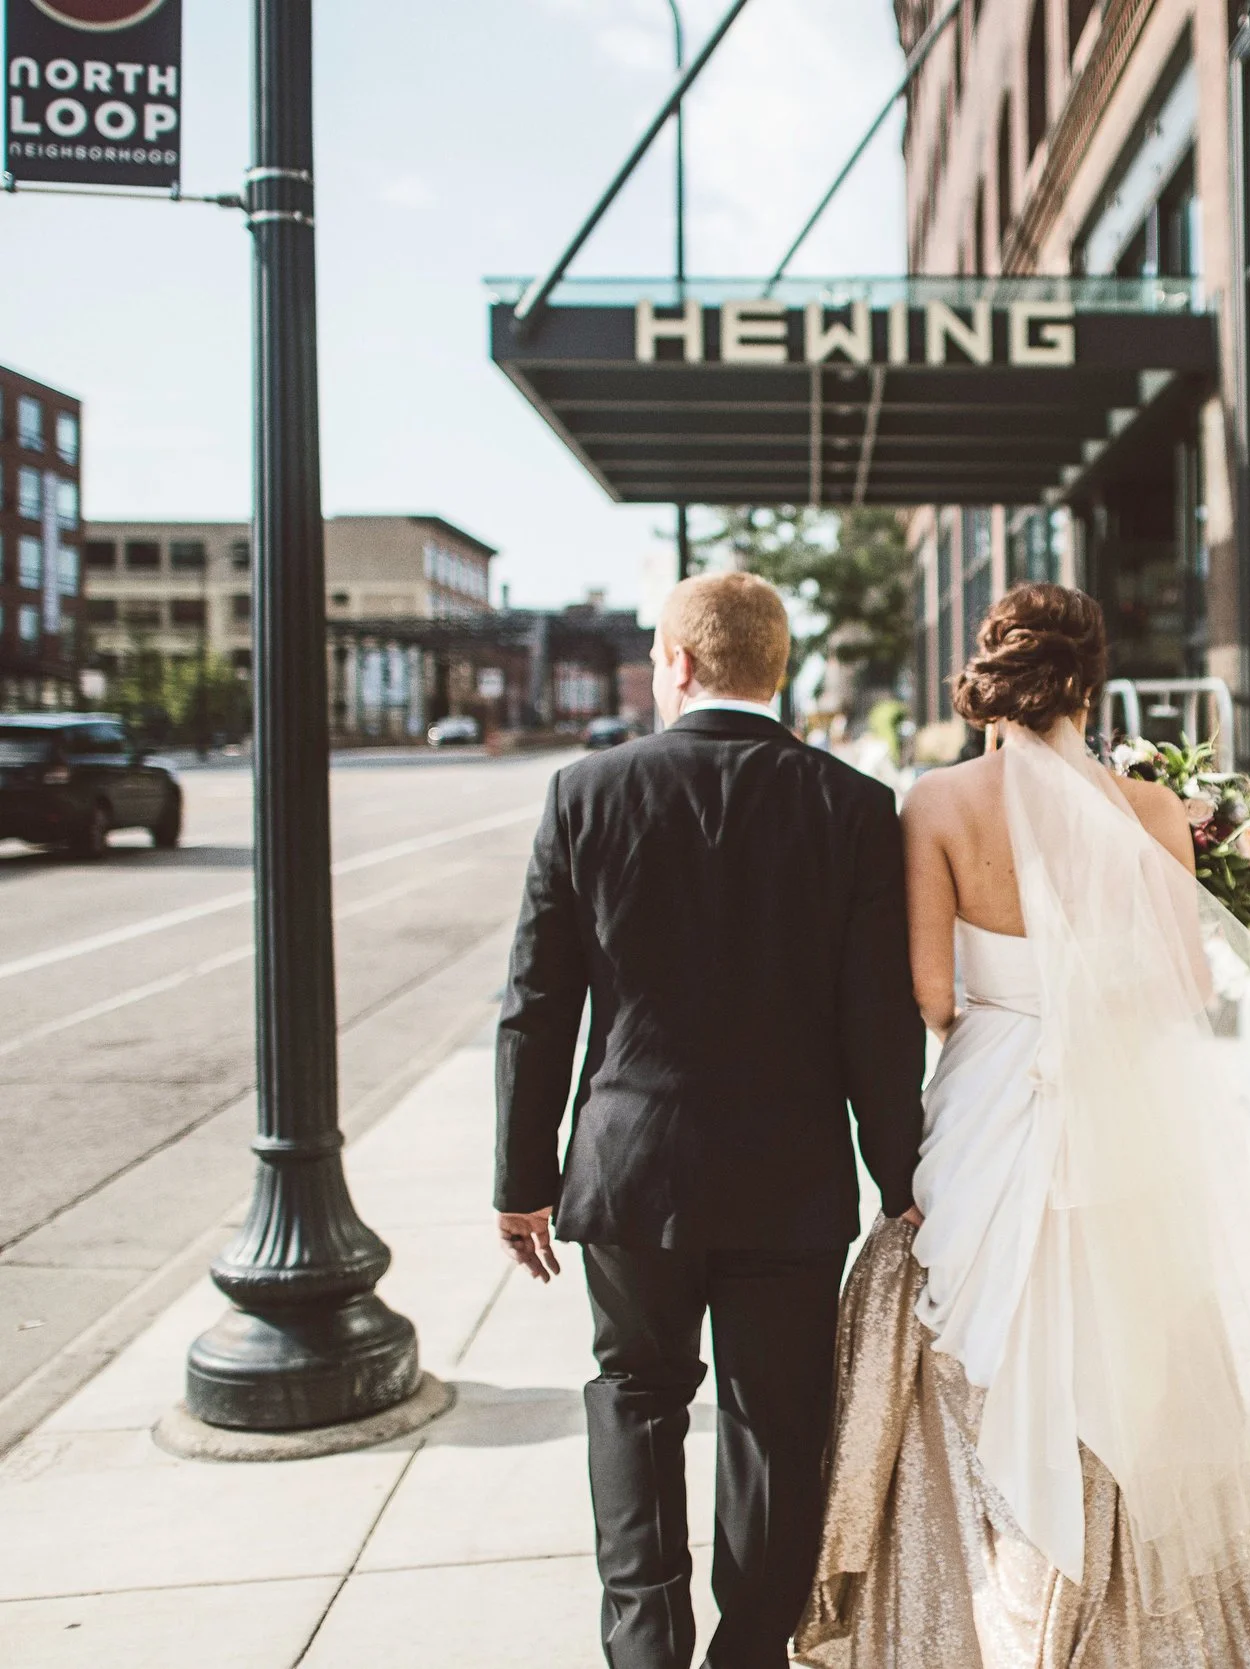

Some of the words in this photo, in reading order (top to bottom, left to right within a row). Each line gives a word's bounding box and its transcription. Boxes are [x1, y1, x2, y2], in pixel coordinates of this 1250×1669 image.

[9, 56, 178, 97] NORTH
[10, 95, 178, 142] LOOP
[9, 141, 179, 165] NEIGHBORHOOD
[634, 299, 1076, 367] HEWING
